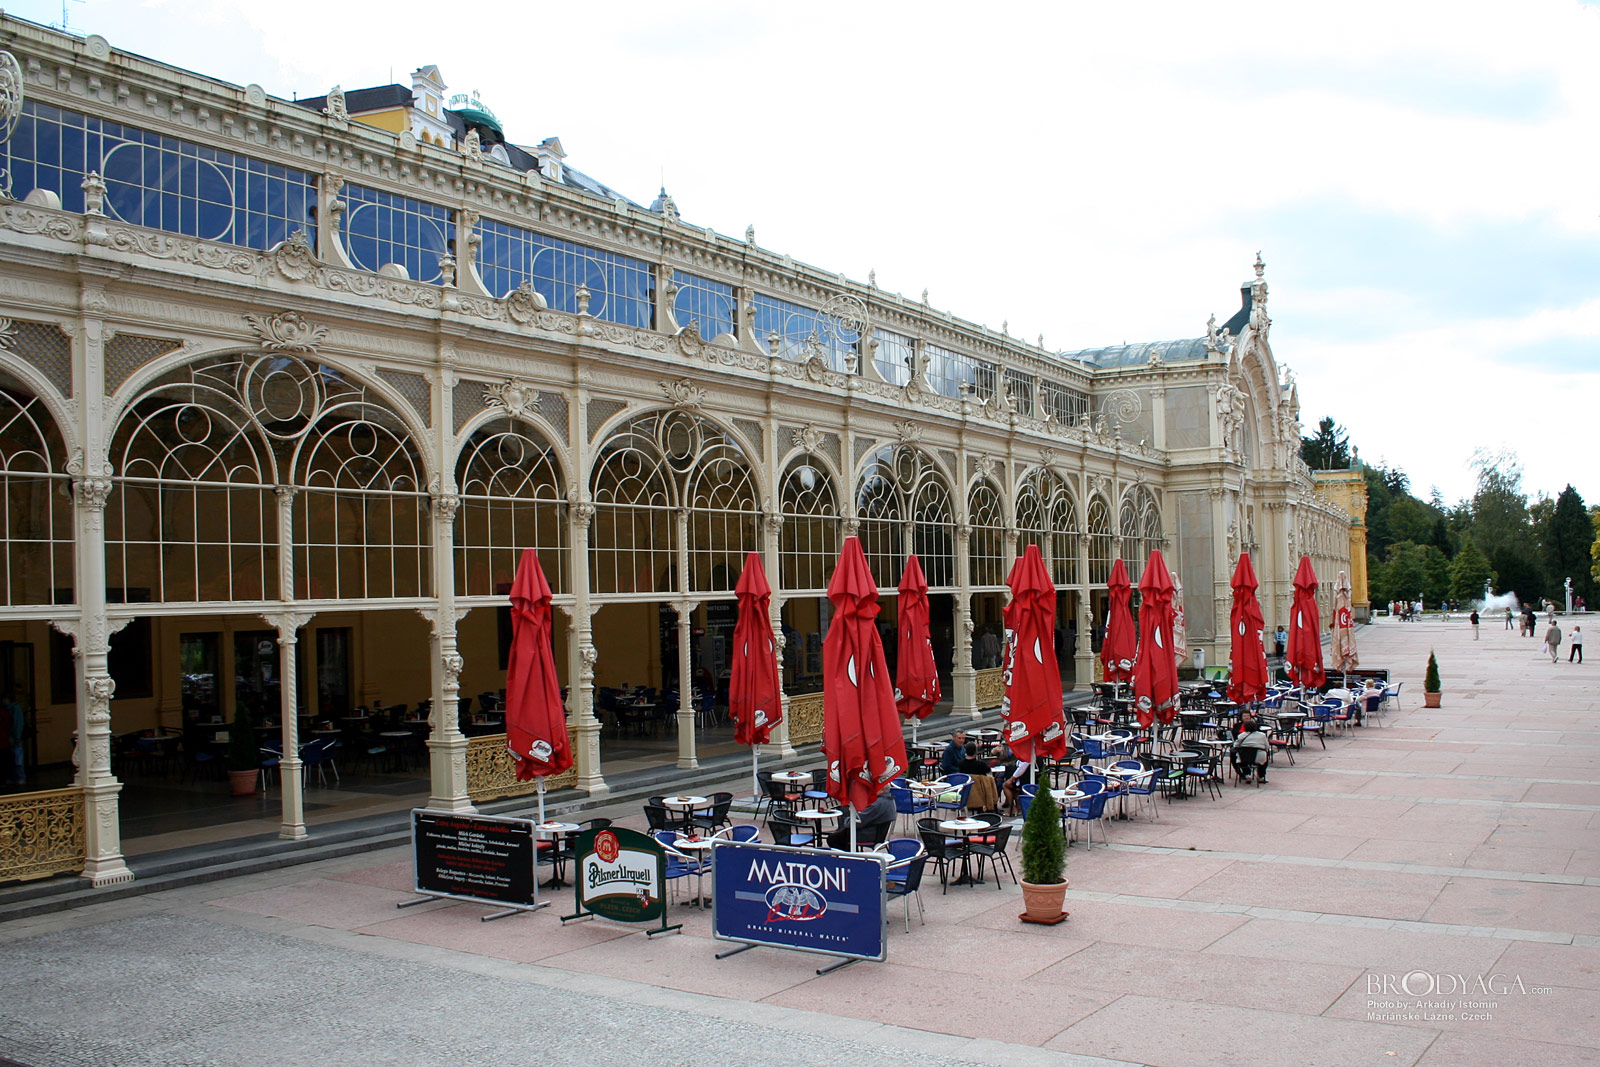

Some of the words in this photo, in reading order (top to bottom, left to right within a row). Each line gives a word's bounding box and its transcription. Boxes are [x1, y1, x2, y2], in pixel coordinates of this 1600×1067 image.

[588, 861, 619, 889] Pilsner
[619, 864, 651, 886] Urquell
[747, 858, 846, 892] MATTONI
[747, 924, 773, 932] GRAND
[778, 928, 814, 938] MINERAL
